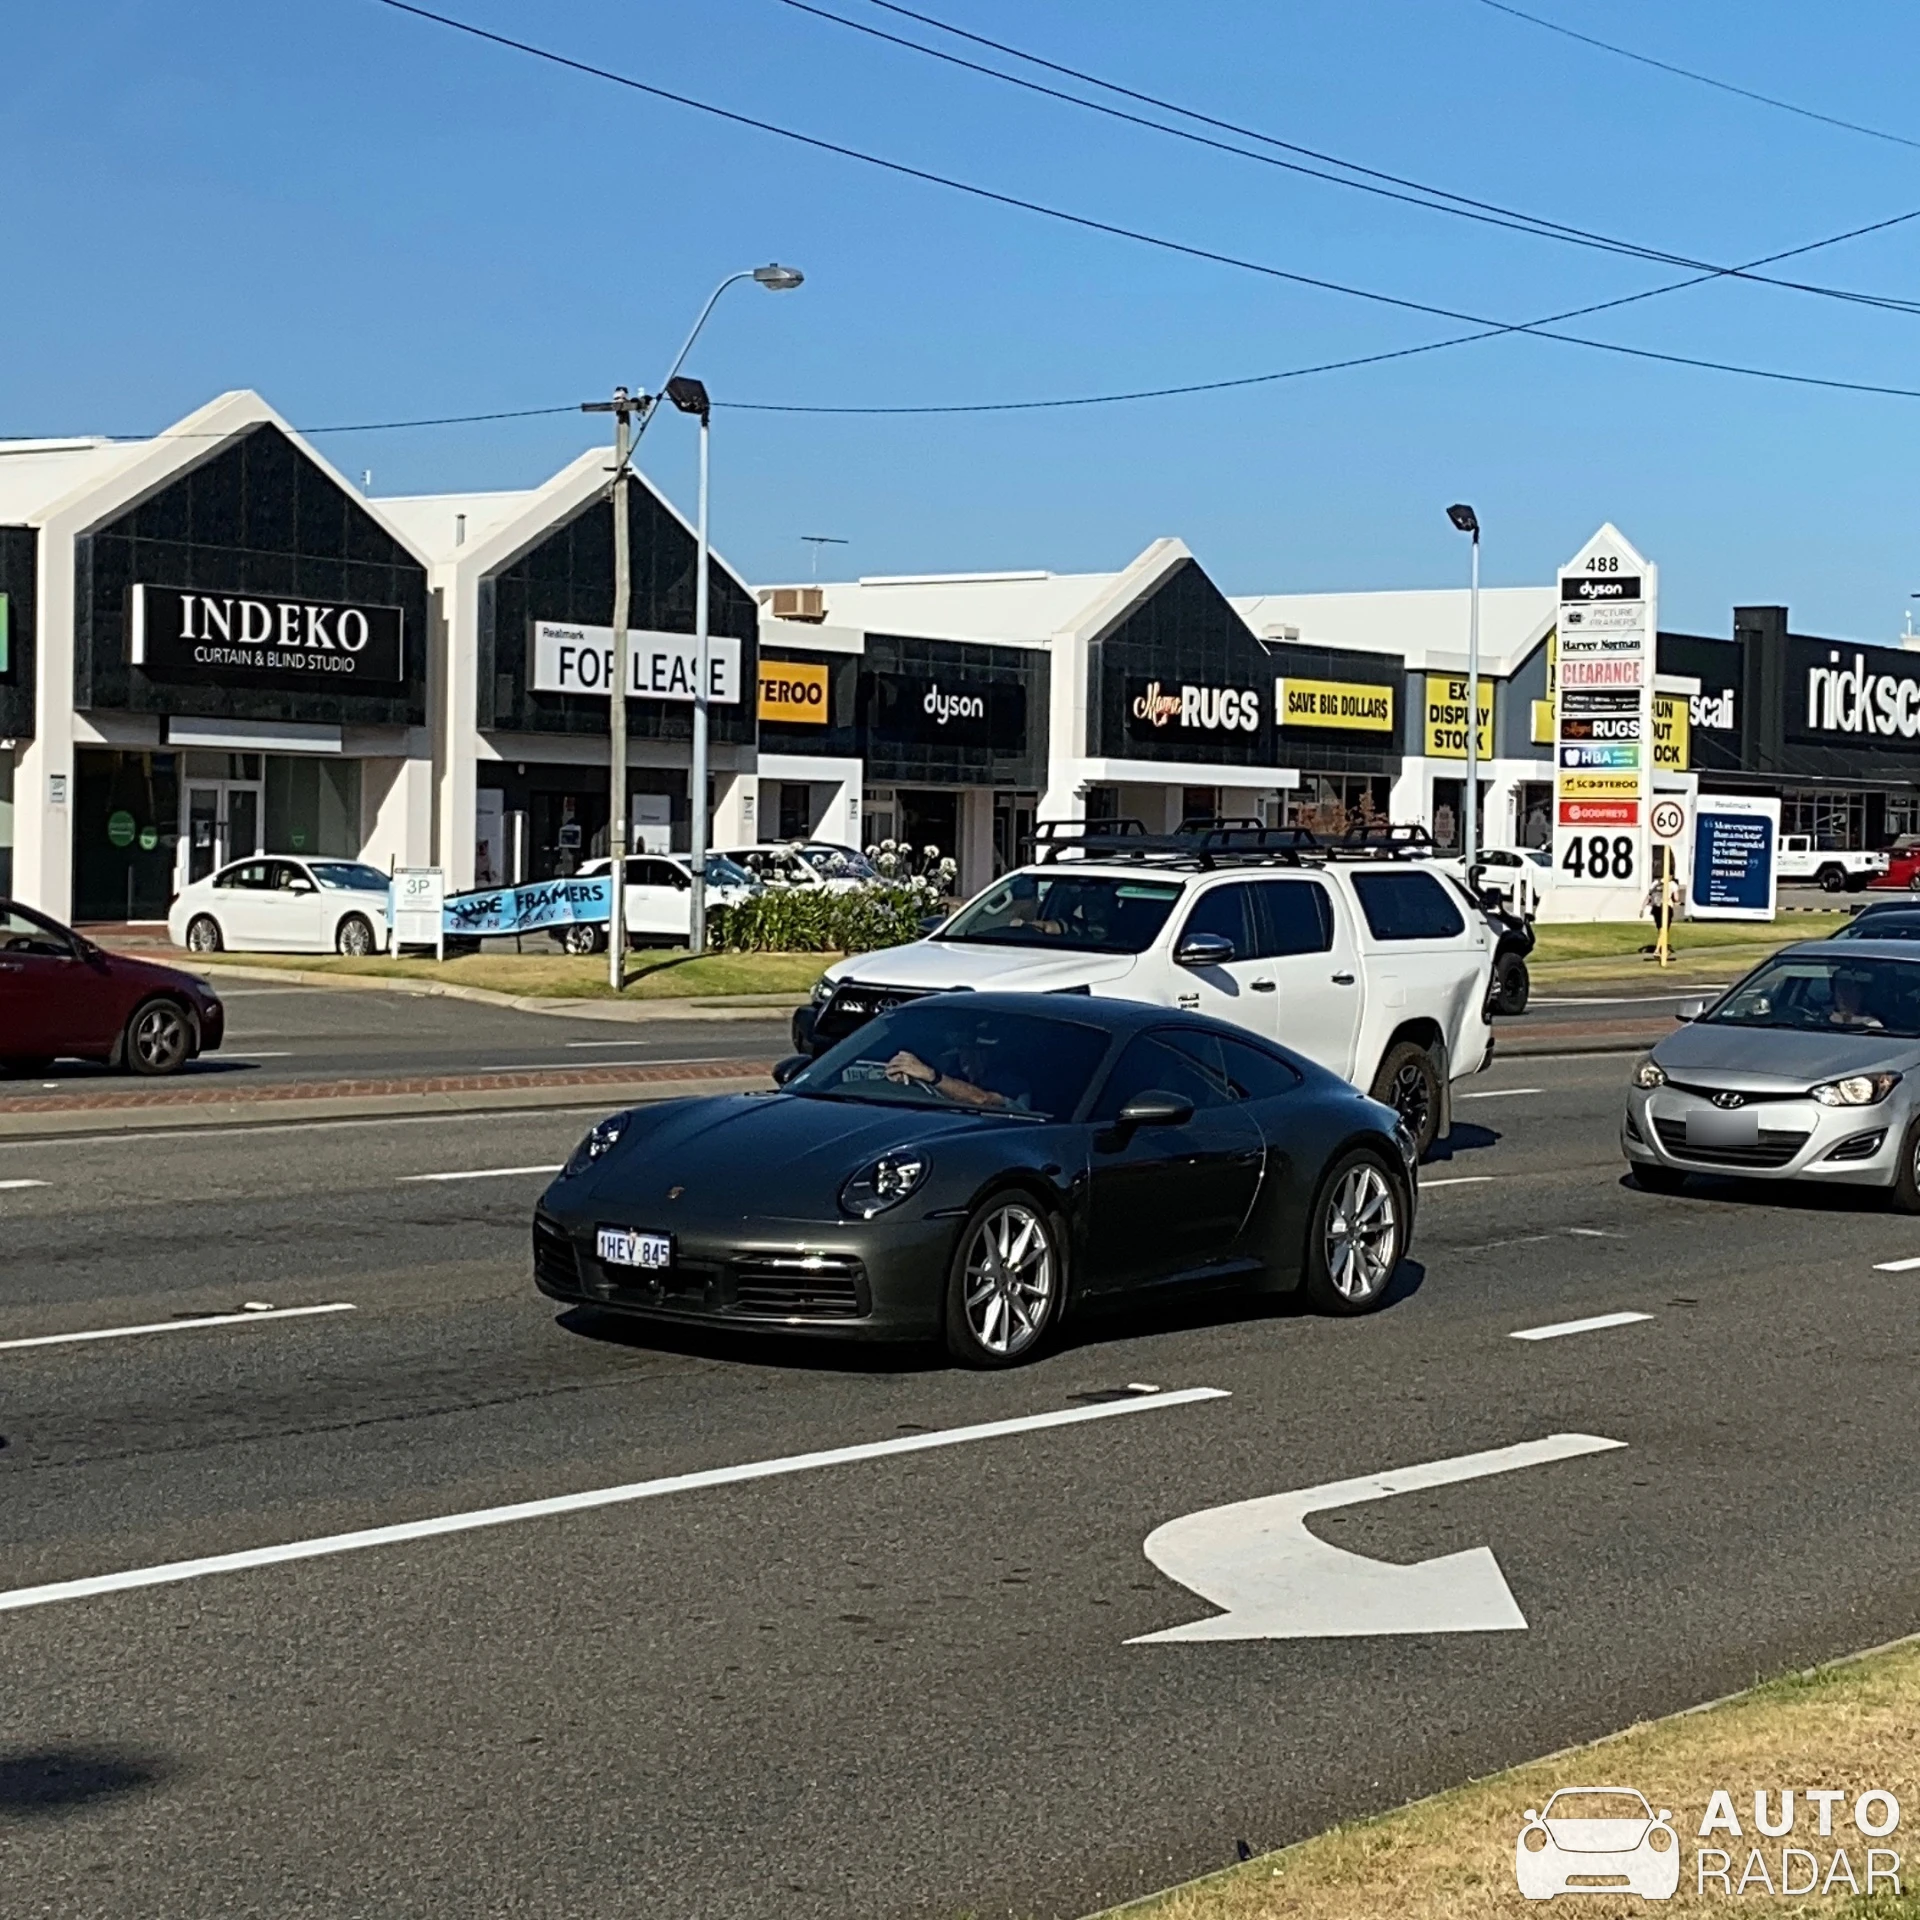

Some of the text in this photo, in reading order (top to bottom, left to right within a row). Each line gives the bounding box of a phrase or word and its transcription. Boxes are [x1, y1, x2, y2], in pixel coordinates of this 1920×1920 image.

[1586, 556, 1618, 572] 488
[1580, 581, 1622, 600] dyson
[180, 595, 368, 651] INDEKO
[543, 627, 584, 640] Realmark
[1563, 640, 1641, 651] Harvey Norman
[194, 646, 355, 672] CURTAIN & BLIND STUDIO
[1562, 662, 1640, 684] CLEARANCE
[923, 684, 984, 724] dyson
[1320, 694, 1338, 715] BIG
[1809, 650, 1920, 738] nicksc
[1181, 686, 1259, 732] RUGS
[1653, 701, 1673, 718] UN
[1592, 720, 1640, 738] RUGS
[1582, 750, 1612, 764] HBA
[1657, 811, 1678, 828] 60
[1562, 836, 1634, 879] 488
[406, 879, 431, 894] 3P
[516, 885, 604, 912] FRAMERS
[601, 1236, 669, 1265] 1HEV 845
